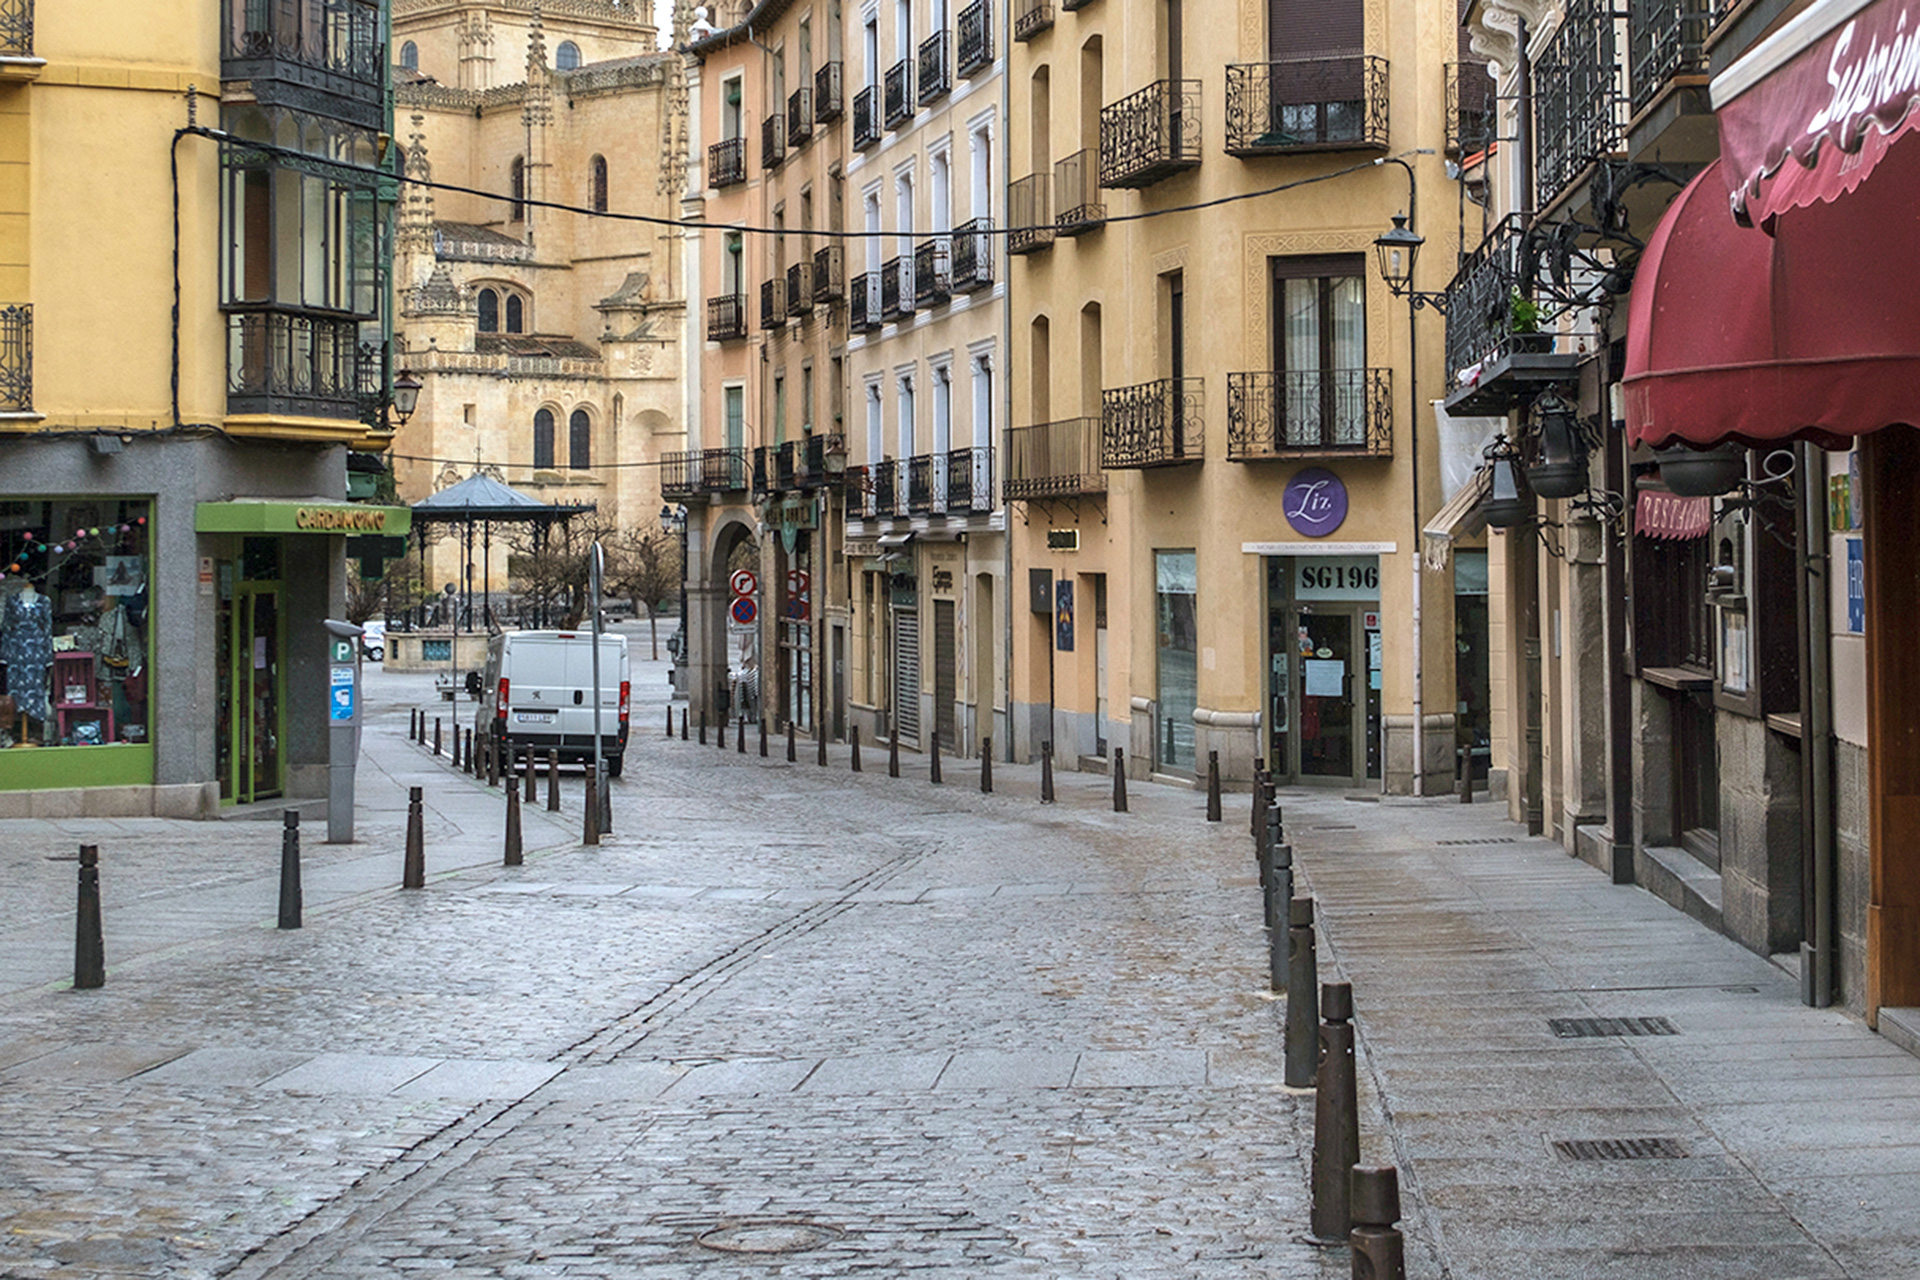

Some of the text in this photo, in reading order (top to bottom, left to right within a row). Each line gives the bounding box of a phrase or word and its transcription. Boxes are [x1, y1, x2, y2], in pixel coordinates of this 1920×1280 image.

[1287, 480, 1332, 523] Liz
[296, 507, 386, 530] CARDAMOMO
[1302, 566, 1379, 589] SG196
[337, 642, 350, 661] P
